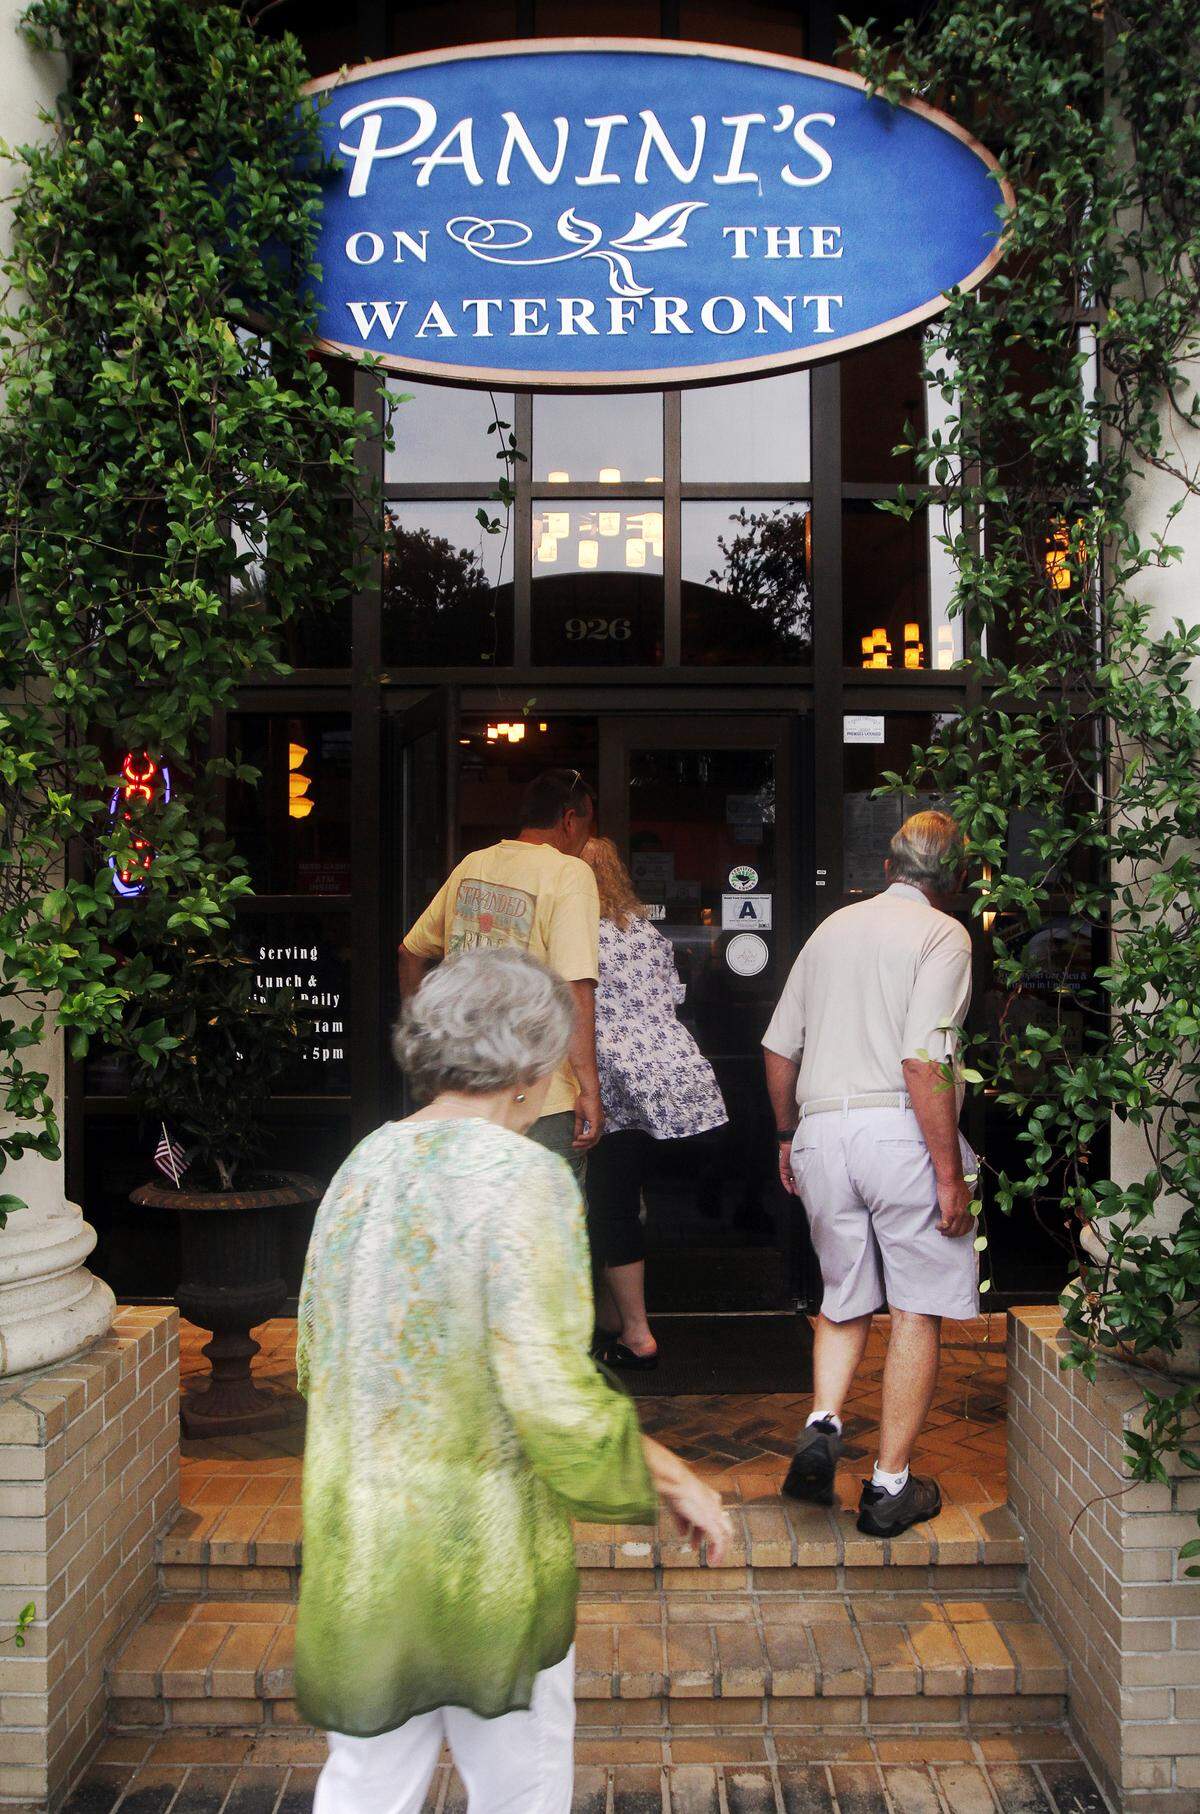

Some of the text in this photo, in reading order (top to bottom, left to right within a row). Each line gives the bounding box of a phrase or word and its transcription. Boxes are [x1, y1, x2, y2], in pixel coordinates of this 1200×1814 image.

[338, 97, 836, 198] PANINI'S
[345, 226, 844, 264] ON THE
[346, 295, 844, 341] WATERFRONT
[564, 618, 632, 640] 926
[738, 901, 757, 919] A
[259, 946, 318, 962] Serving
[256, 975, 318, 989] Lunch &
